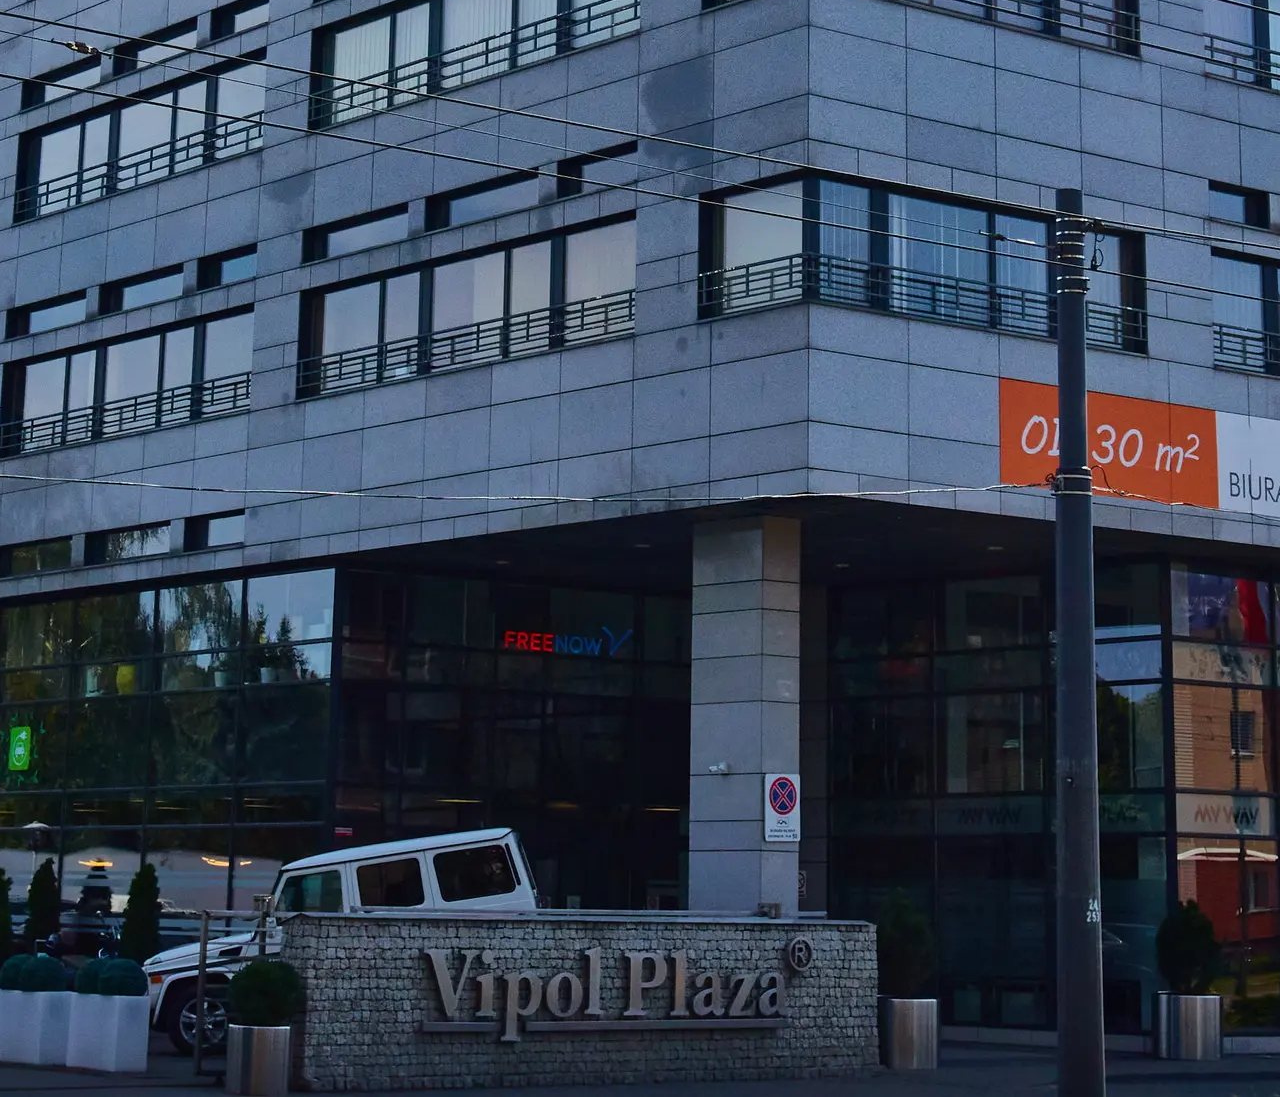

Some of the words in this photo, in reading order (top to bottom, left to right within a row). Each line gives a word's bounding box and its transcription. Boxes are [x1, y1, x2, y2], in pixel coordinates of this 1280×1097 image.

[1091, 424, 1144, 468] 30
[424, 946, 602, 1042] Vipol
[624, 947, 787, 1018] Plaza
